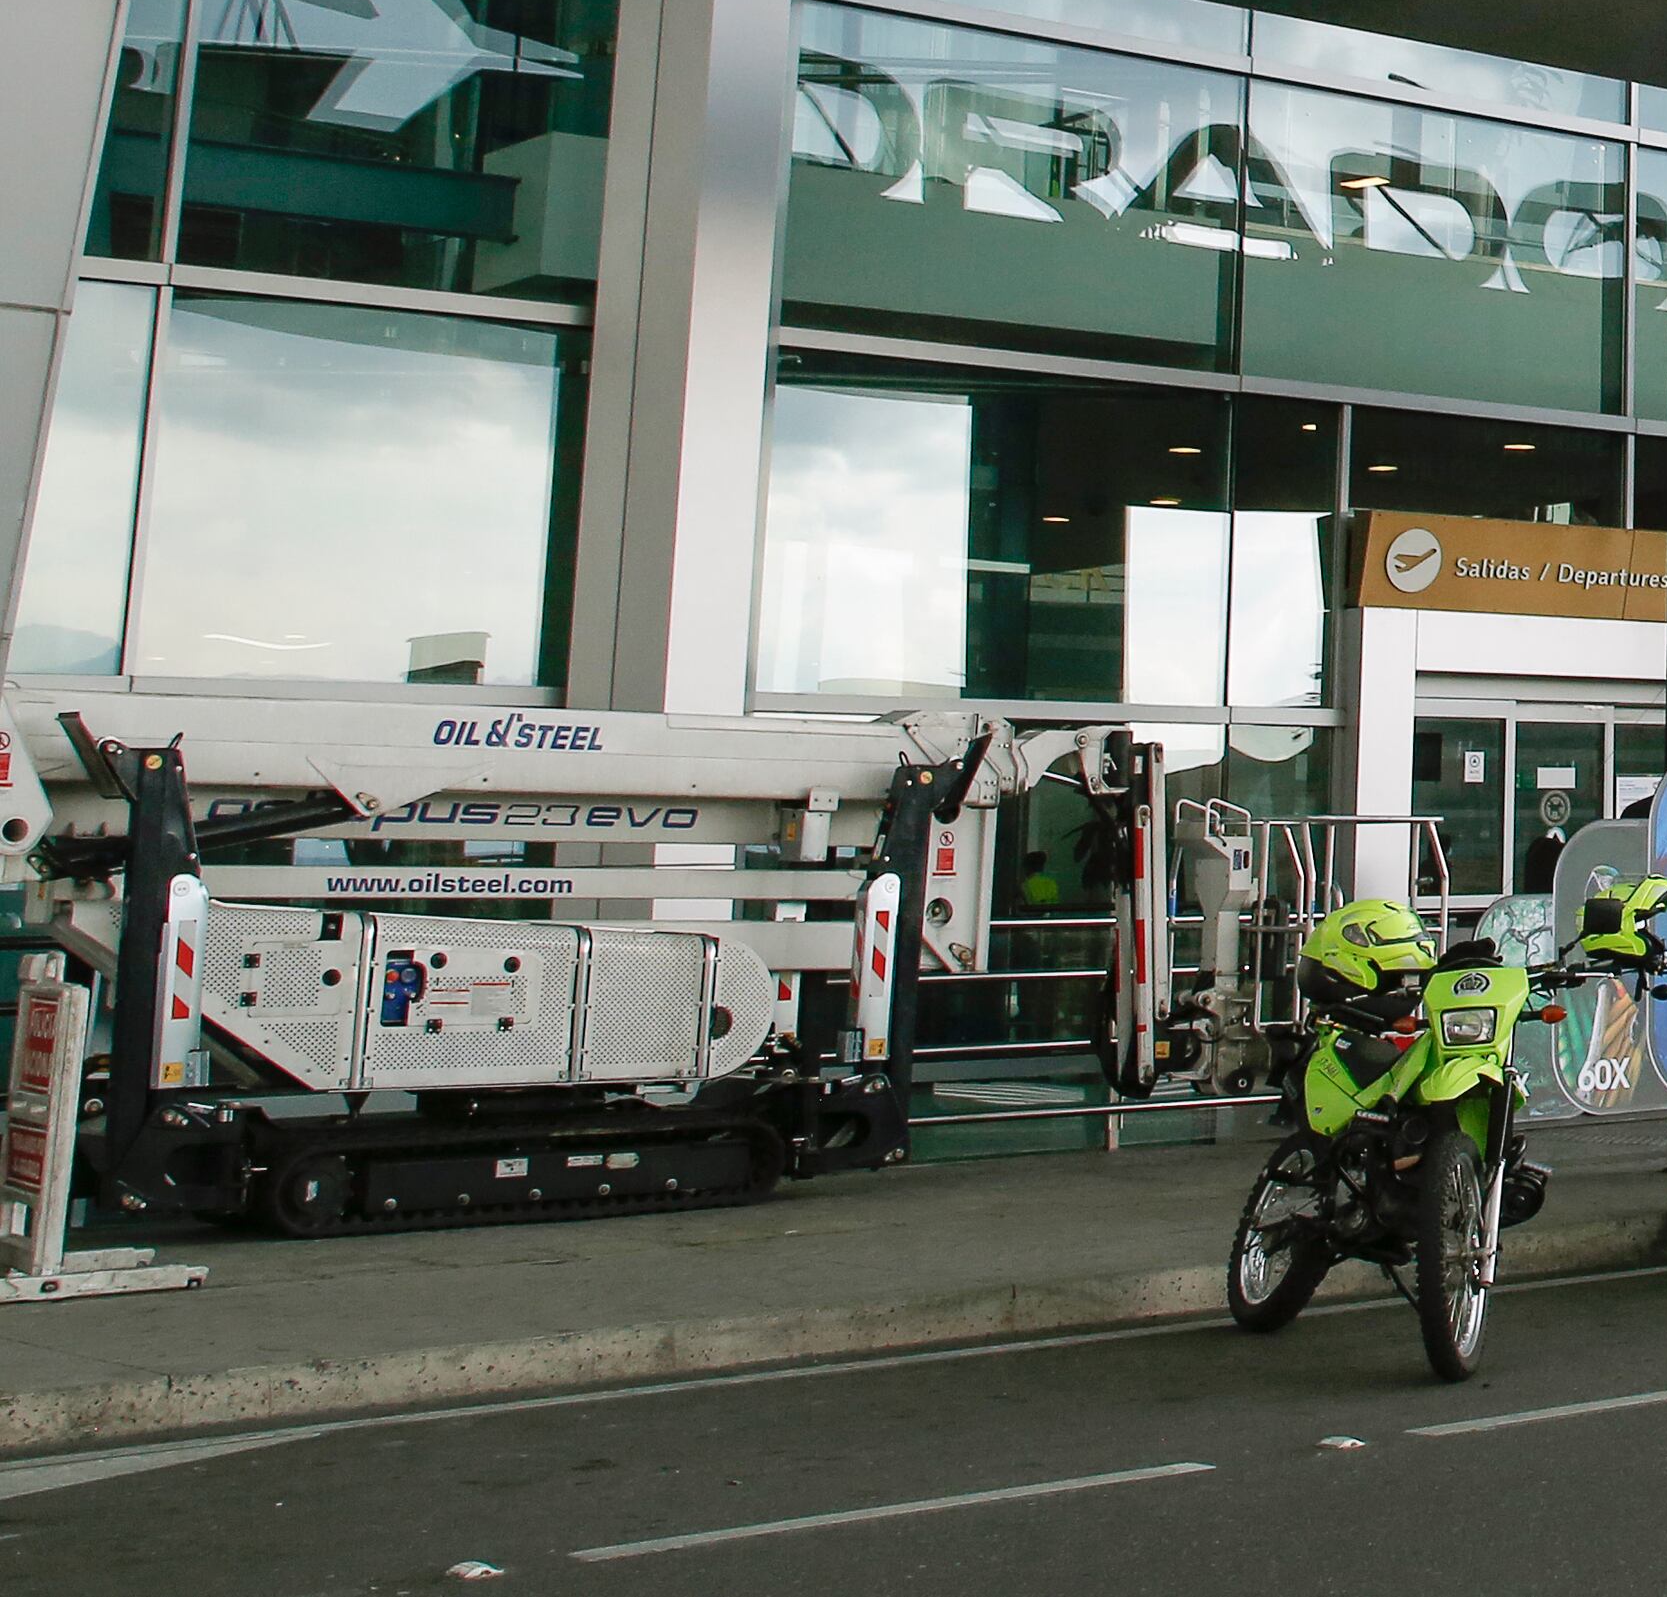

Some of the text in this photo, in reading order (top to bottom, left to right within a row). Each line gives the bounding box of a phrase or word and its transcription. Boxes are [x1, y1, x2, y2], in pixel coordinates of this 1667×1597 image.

[1455, 556, 1667, 590] Salidas / Departures
[586, 806, 699, 829] evo
[326, 874, 574, 896] www.oilsteel.com
[1577, 1057, 1631, 1093] 60X
